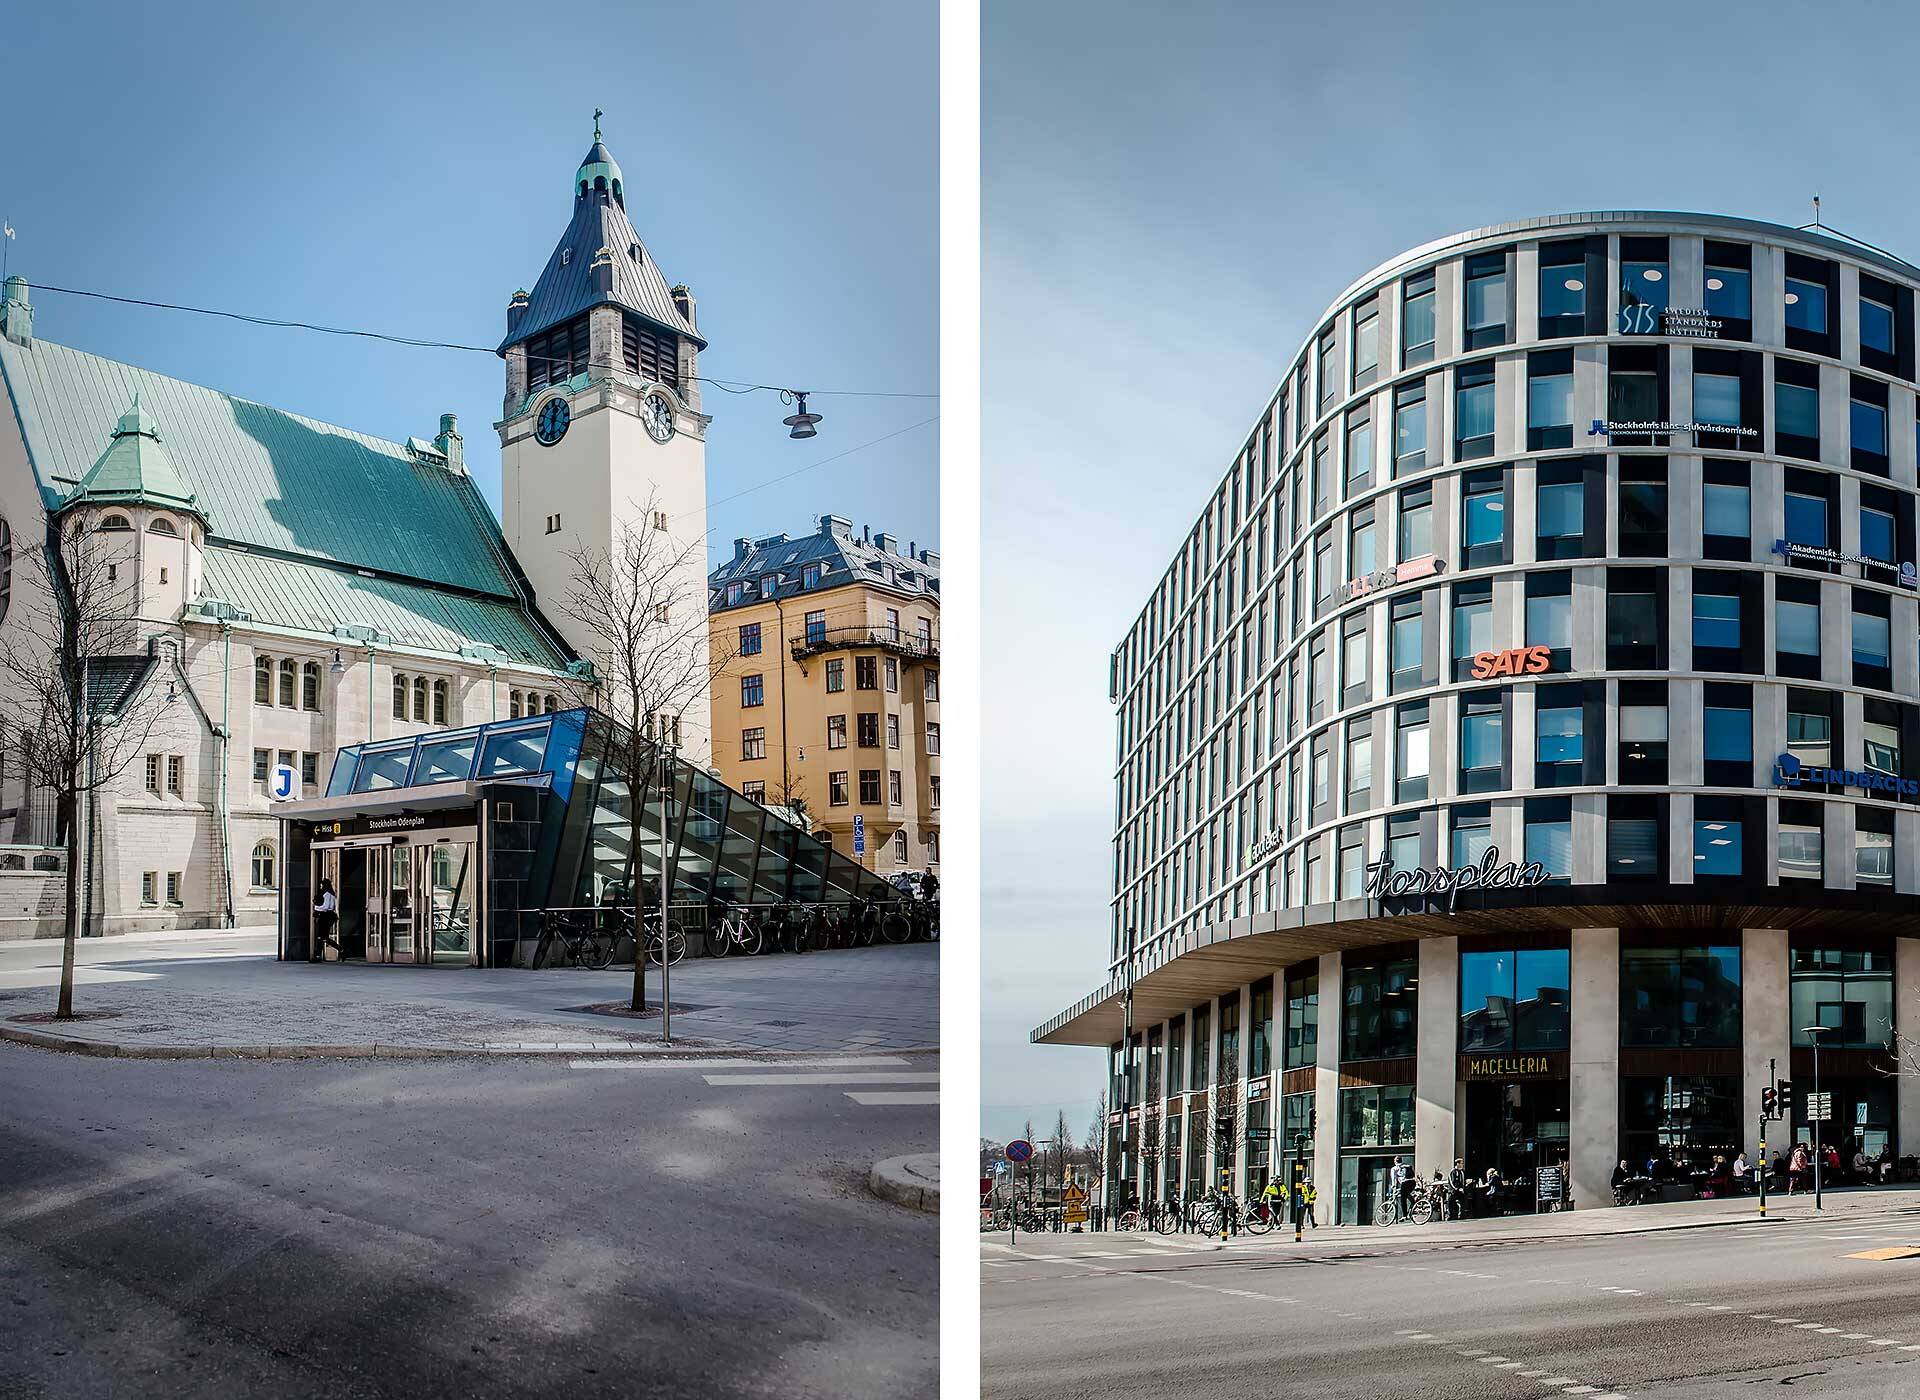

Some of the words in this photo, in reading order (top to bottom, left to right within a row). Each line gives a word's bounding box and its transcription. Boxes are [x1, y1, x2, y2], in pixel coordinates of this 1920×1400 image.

[1664, 306, 1709, 316] SWEDISH
[1664, 317, 1723, 328] STANDARDS
[1664, 328, 1719, 338] INSTITUTE
[1608, 420, 1659, 430] Stockholms
[1683, 422, 1758, 437] sjukvårdsområde
[1470, 645, 1551, 679] SATS
[275, 769, 291, 797] J
[369, 818, 397, 829] Stockholm
[398, 816, 425, 829] Odenplan
[855, 816, 862, 824] P
[321, 825, 333, 833] Hiss
[1366, 844, 1551, 915] torsplan
[1471, 1057, 1548, 1075] MACELLERIA
